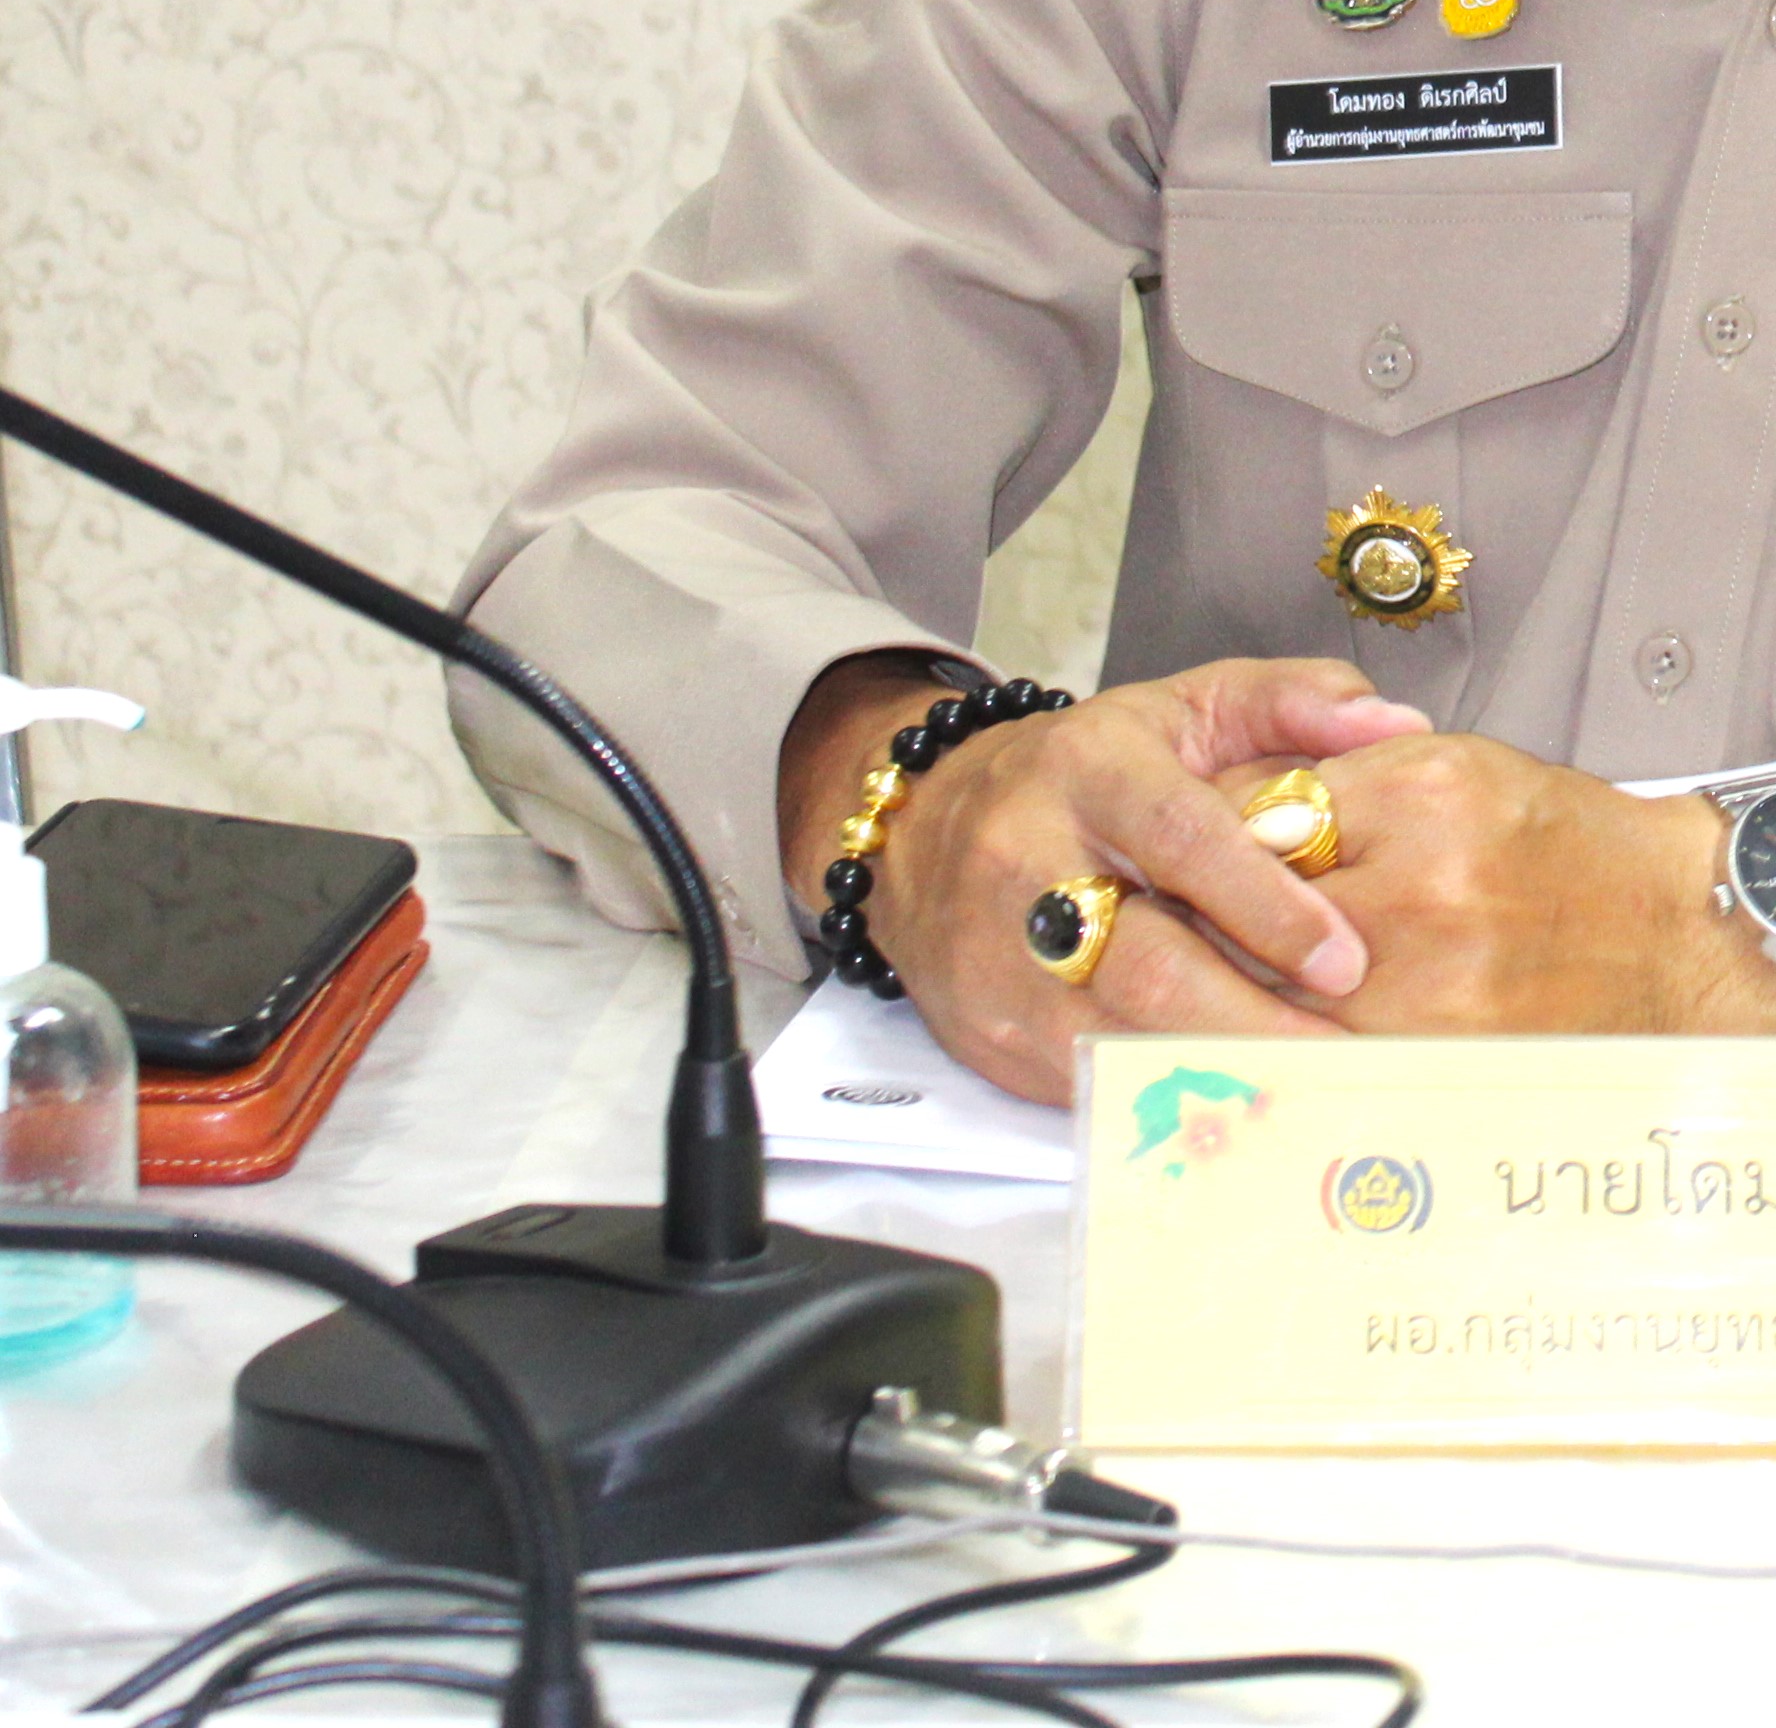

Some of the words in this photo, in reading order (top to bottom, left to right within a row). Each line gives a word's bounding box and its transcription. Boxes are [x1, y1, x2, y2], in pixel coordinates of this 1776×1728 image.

[1328, 87, 1405, 113] โดมทอง
[1419, 76, 1507, 108] ดิเรกศิลป์
